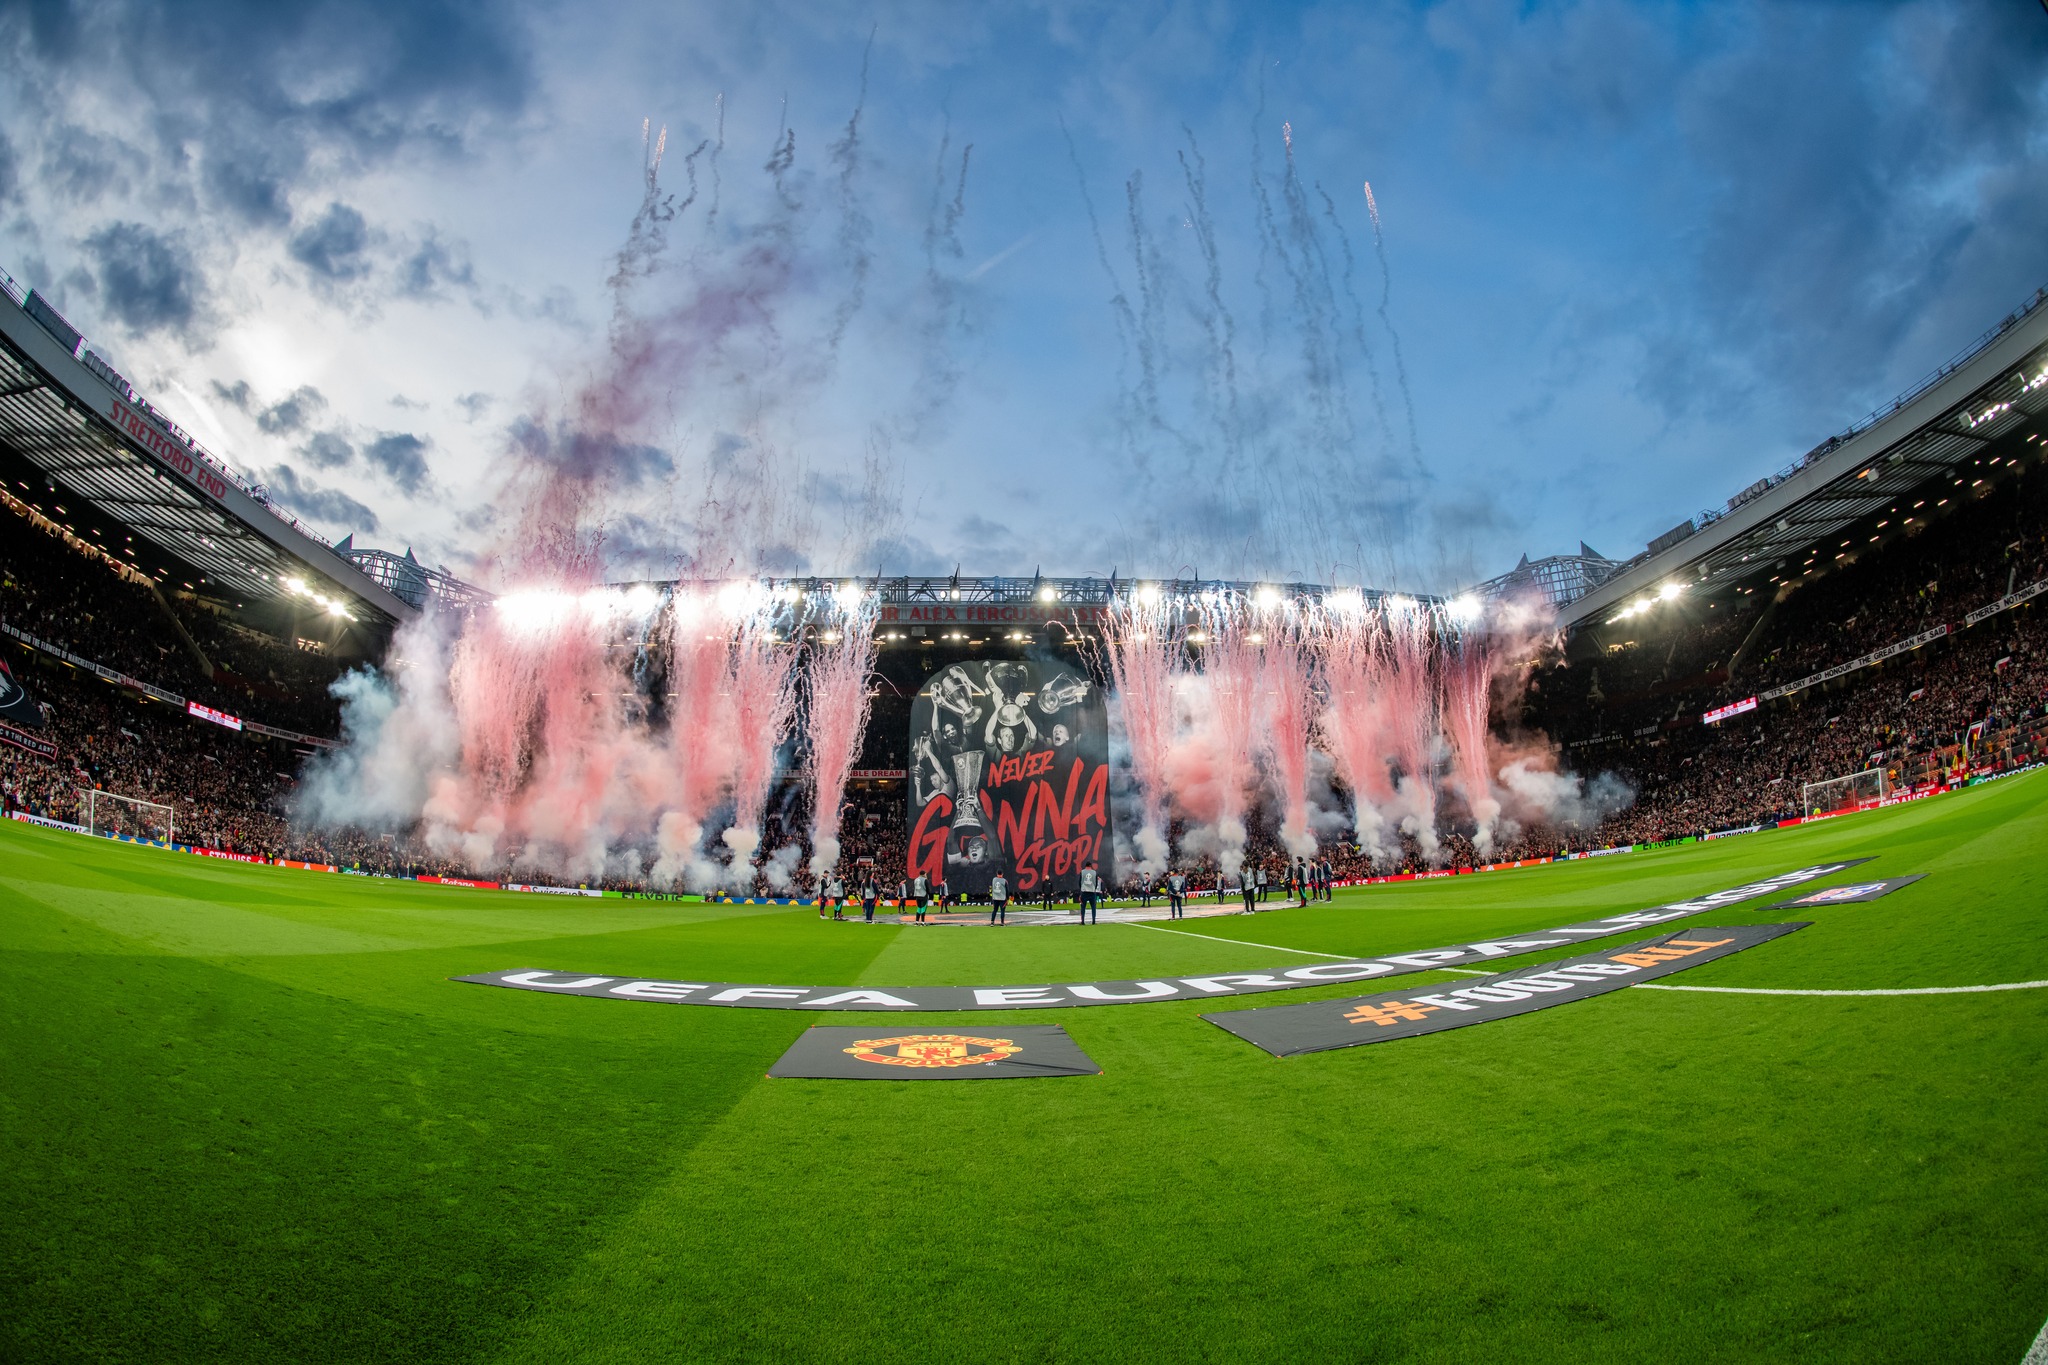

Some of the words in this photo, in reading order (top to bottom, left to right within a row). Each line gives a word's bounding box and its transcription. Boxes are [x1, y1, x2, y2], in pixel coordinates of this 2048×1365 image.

[109, 400, 193, 475] STRETFORD
[197, 466, 227, 499] END
[2003, 586, 2036, 607] NOTHING
[909, 606, 957, 621] ALEX
[966, 607, 1069, 621] FERGUSON
[67, 652, 96, 671] MANCHESTER
[1785, 680, 1806, 691] GLORY
[1808, 673, 1822, 684] AND
[1858, 655, 1872, 666] THE
[1873, 646, 1896, 660] GREAT
[1898, 638, 1915, 651] MAN
[1916, 633, 1927, 643] HE
[1929, 626, 1946, 639] SAID
[11, 731, 22, 743] THE
[23, 737, 37, 748] RED
[1589, 737, 1604, 745] WON
[1611, 733, 1623, 741] ALL
[988, 750, 1055, 788] NEVER
[208, 850, 252, 863] STRAUSS
[1016, 829, 1104, 890] STOP!
[501, 971, 919, 1007] UEFA
[973, 938, 1573, 1007] EUROPA
[1342, 937, 1736, 1027] #FOOTBALL
